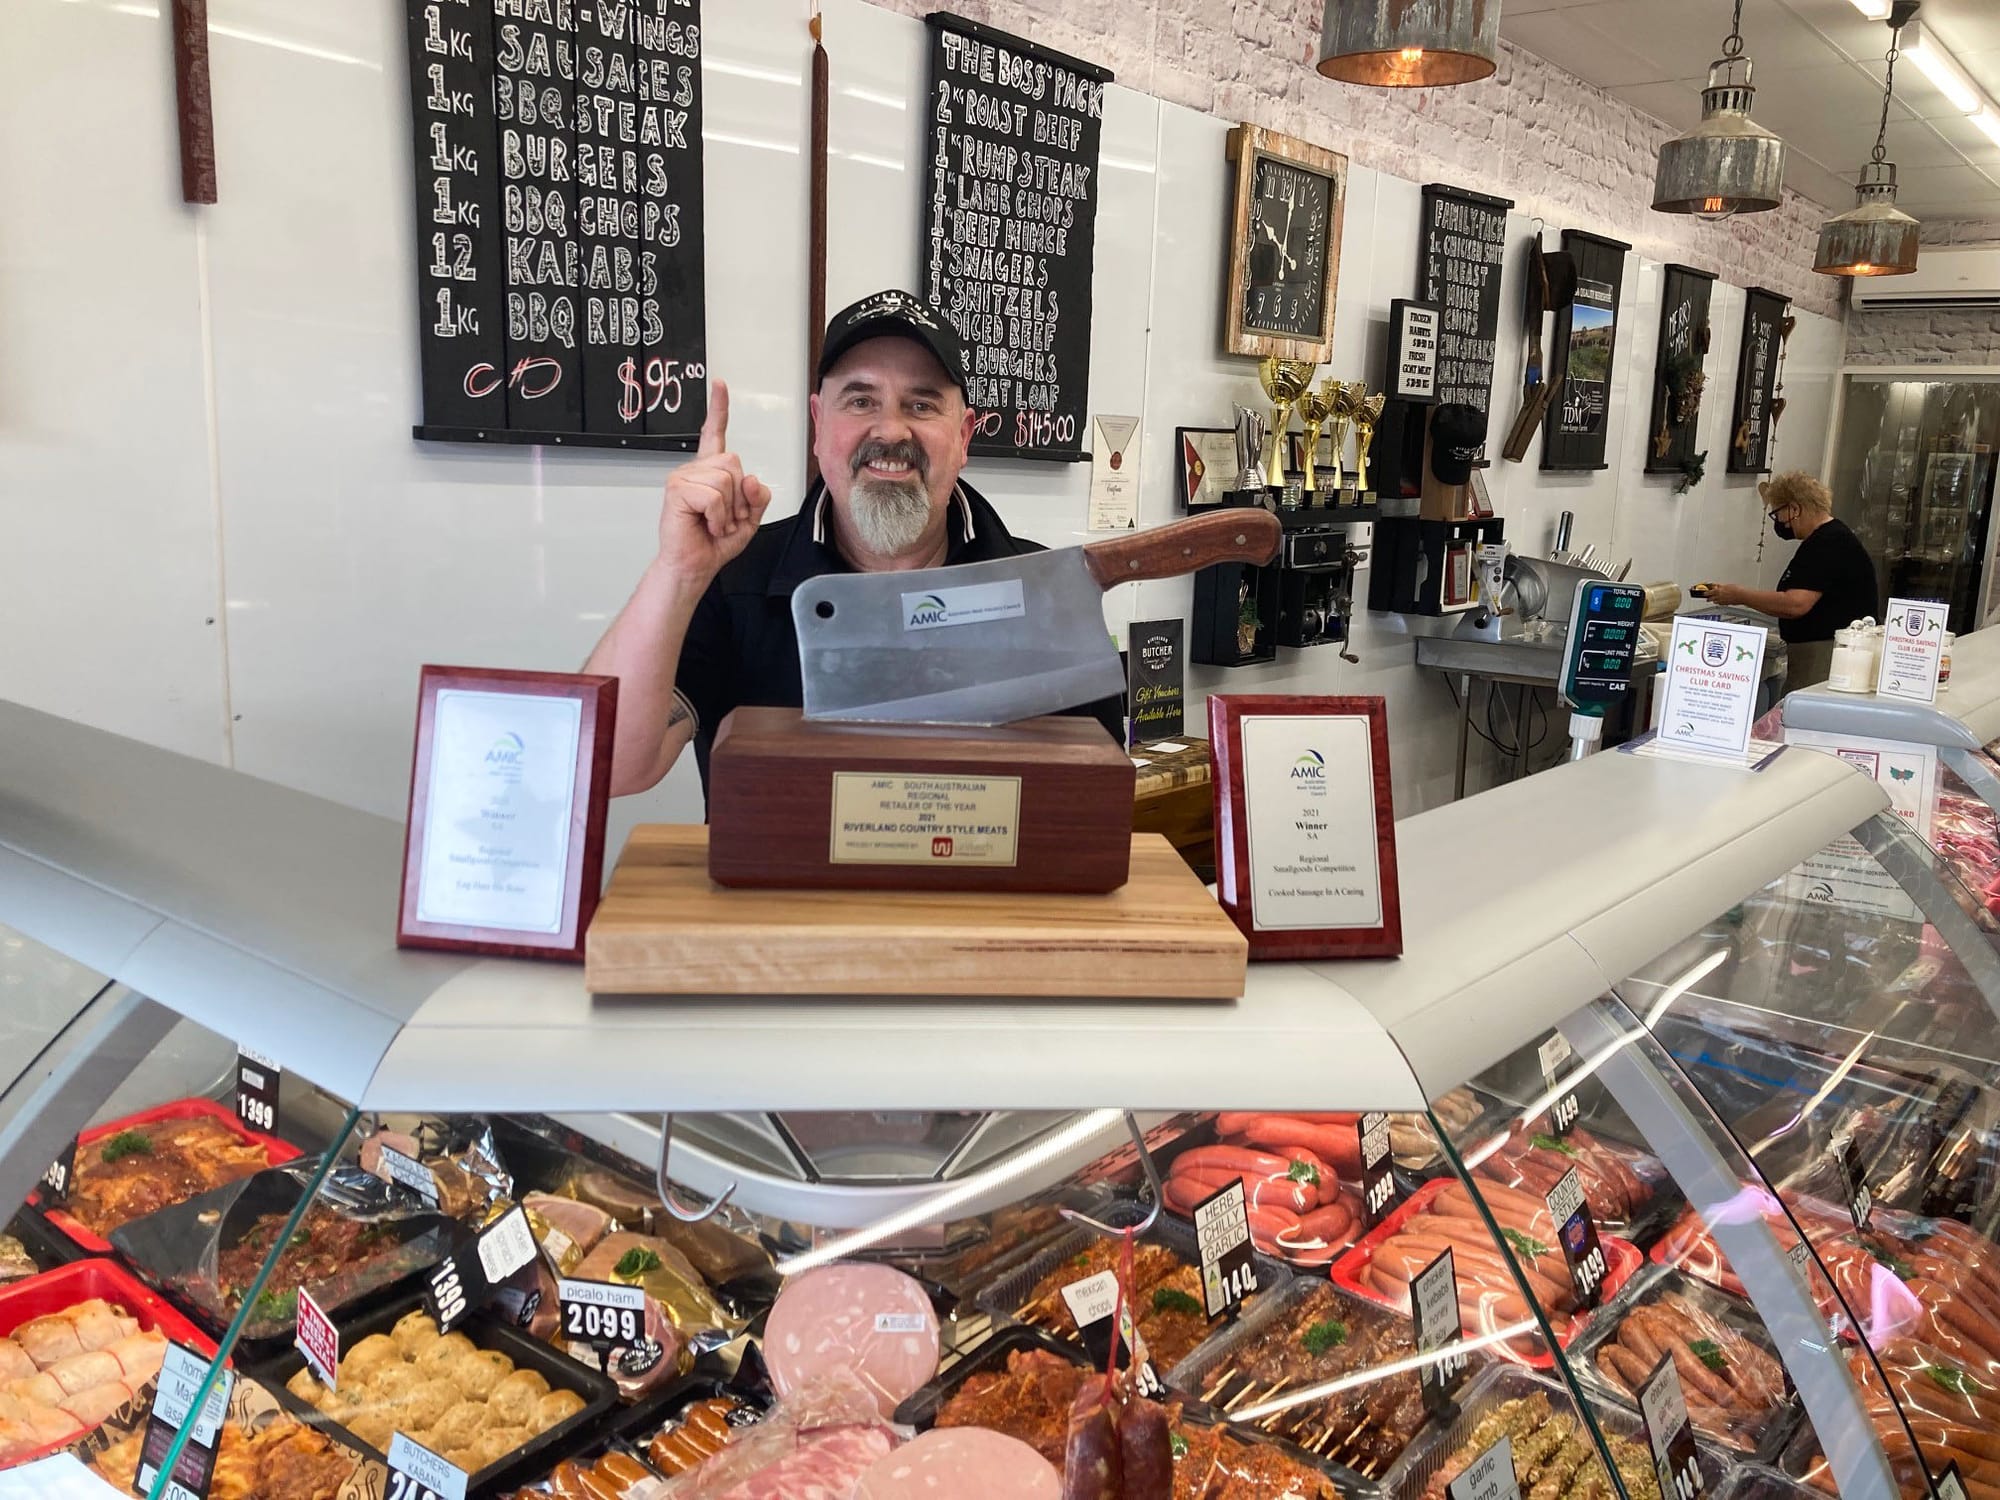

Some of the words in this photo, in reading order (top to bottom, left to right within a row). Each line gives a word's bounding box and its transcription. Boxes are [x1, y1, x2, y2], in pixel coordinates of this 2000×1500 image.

[497, 24, 693, 106] SAUSAGES
[942, 30, 995, 83] THE
[1054, 67, 1104, 119] PACK
[492, 75, 564, 130] BBQ
[571, 95, 687, 148] STEAK
[966, 88, 1028, 136] ROAST
[1034, 110, 1082, 151] BEEF
[503, 129, 668, 197] BURGERS
[962, 135, 1017, 182] RUMP
[1017, 152, 1091, 200] STEAK
[1265, 175, 1275, 199] 11
[957, 174, 1010, 215] LAMB
[1015, 190, 1074, 229] CHOPS
[505, 184, 567, 238] BBQ
[573, 196, 680, 246] CHOPS
[1309, 210, 1317, 232] 2
[953, 209, 1000, 247] BEEF
[1004, 218, 1067, 256] MINCE
[430, 232, 477, 281] 12
[949, 243, 1048, 289] SNAGERS
[1446, 258, 1489, 287] BREAST
[950, 279, 1059, 323] SNITZELS
[508, 292, 575, 349] BBQ
[588, 297, 664, 346] RIBS
[951, 310, 1004, 344] DICED
[1009, 317, 1056, 351] BEEF
[1669, 299, 1692, 338] MERRY
[976, 344, 1057, 383] BURGERS
[1016, 381, 1059, 412] LOAF
[1563, 406, 1582, 425] TDM
[1612, 588, 1627, 596] TOTAL
[1627, 589, 1641, 597] PRICE
[910, 610, 948, 626] AMIC
[1617, 620, 1635, 628] WEIGHT
[1142, 644, 1173, 658] BUTCHER
[1888, 635, 1915, 646] CHRISTMAS
[1675, 665, 1716, 679] CHRISTMAS
[1717, 670, 1751, 683] SAVINGS
[1689, 678, 1709, 687] CLUB
[1711, 681, 1732, 690] CARD
[1136, 686, 1152, 705] Gift
[1153, 683, 1180, 701] Vouchers
[1609, 682, 1626, 691] CAS
[1134, 708, 1164, 725] Available
[1166, 703, 1182, 720] Here
[1290, 766, 1326, 778] AMIC
[904, 782, 934, 791] SOUTH
[934, 782, 987, 792] AUSTRALIAN
[907, 791, 950, 800] REGIONAL
[880, 801, 920, 810] RETAILER
[921, 802, 934, 810] OF
[936, 802, 952, 811] THE
[954, 803, 977, 811] YEAR
[918, 813, 936, 822] 2021
[1302, 809, 1320, 817] 2021
[1896, 808, 1915, 818] ARD
[843, 823, 898, 833] RIVERLAND
[900, 823, 944, 834] COUNTRY
[945, 824, 976, 834] STYLE
[977, 825, 1008, 835] MEATS
[1295, 821, 1328, 830] Winner
[1306, 833, 1319, 841] SA
[1273, 865, 1313, 875] Smallgoods
[1314, 865, 1356, 875] Competition
[1299, 855, 1329, 864] Regional
[1268, 888, 1296, 897] Cooked
[1296, 888, 1324, 898] Sausage
[1341, 888, 1364, 897] Casing
[1806, 892, 1834, 903] AMIC
[1548, 1169, 1579, 1210] COUNTRY
[1205, 1191, 1234, 1220] HERB
[1558, 1190, 1581, 1223] STYLE
[1203, 1208, 1240, 1242] CHILLY
[1206, 1226, 1245, 1262] GARLIC
[1423, 1263, 1448, 1293] chicken
[567, 1286, 604, 1302] picalo
[607, 1289, 635, 1305] ham
[309, 1307, 326, 1337] THIS
[1429, 1303, 1449, 1327] honey
[403, 1441, 450, 1479] BUTCHERS
[408, 1462, 442, 1491] KABANA
[1469, 1457, 1495, 1490] garlic
